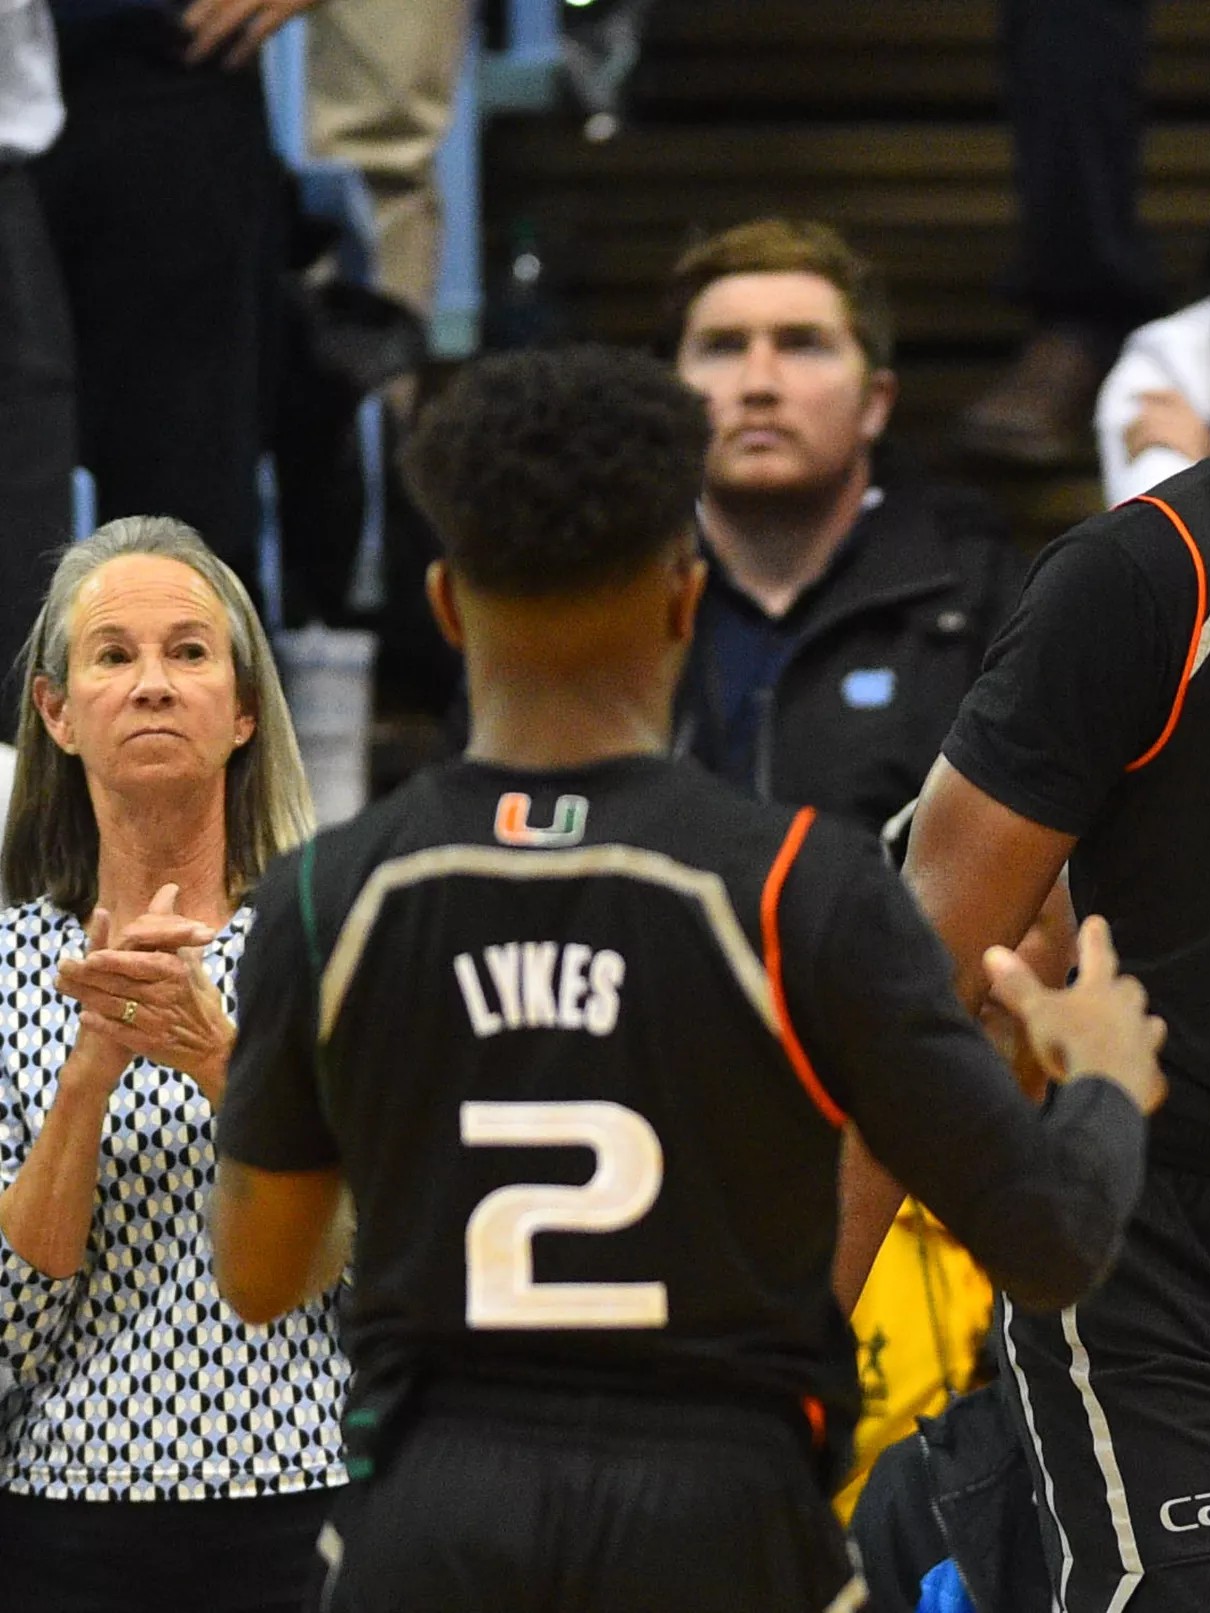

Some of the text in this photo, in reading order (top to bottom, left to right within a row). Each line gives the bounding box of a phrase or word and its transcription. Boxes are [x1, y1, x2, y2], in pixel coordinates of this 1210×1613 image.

[494, 792, 589, 849] U
[453, 941, 626, 1038] LYKES
[460, 1100, 668, 1330] 2
